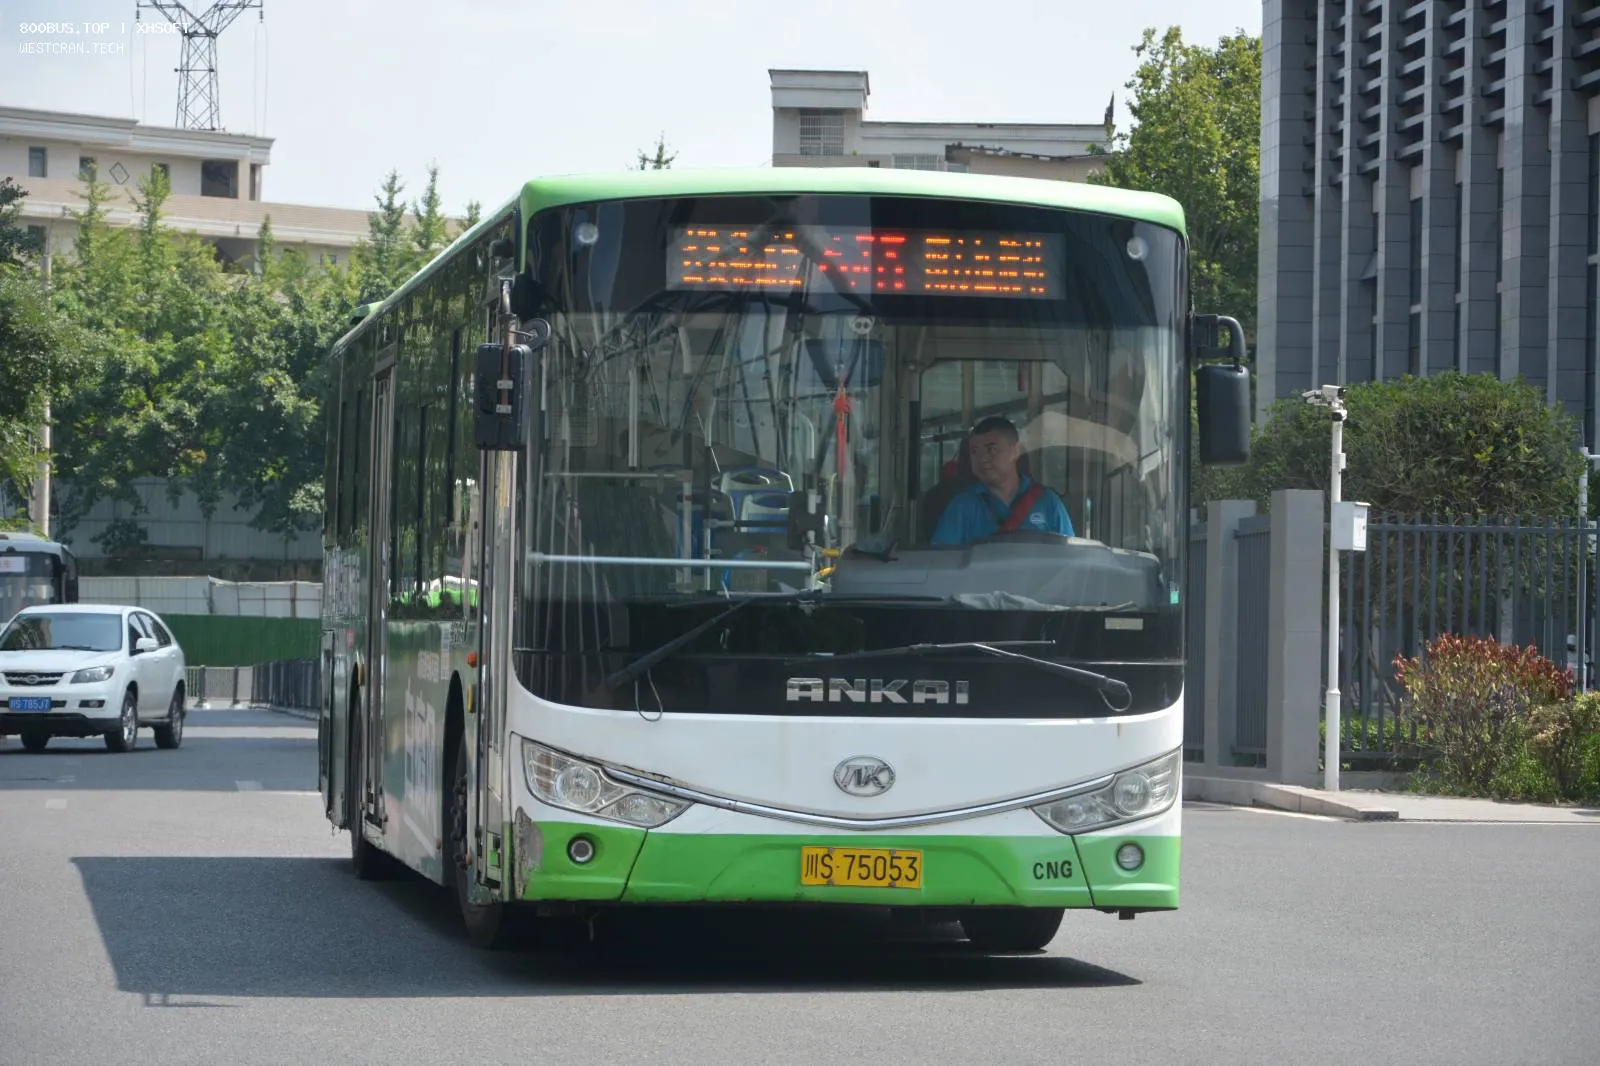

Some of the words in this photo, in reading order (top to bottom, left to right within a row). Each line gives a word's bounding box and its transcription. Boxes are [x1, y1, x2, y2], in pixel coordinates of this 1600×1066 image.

[786, 677, 969, 705] ANKAI
[804, 853, 918, 882] 川S·75053
[1033, 860, 1073, 880] CNG
